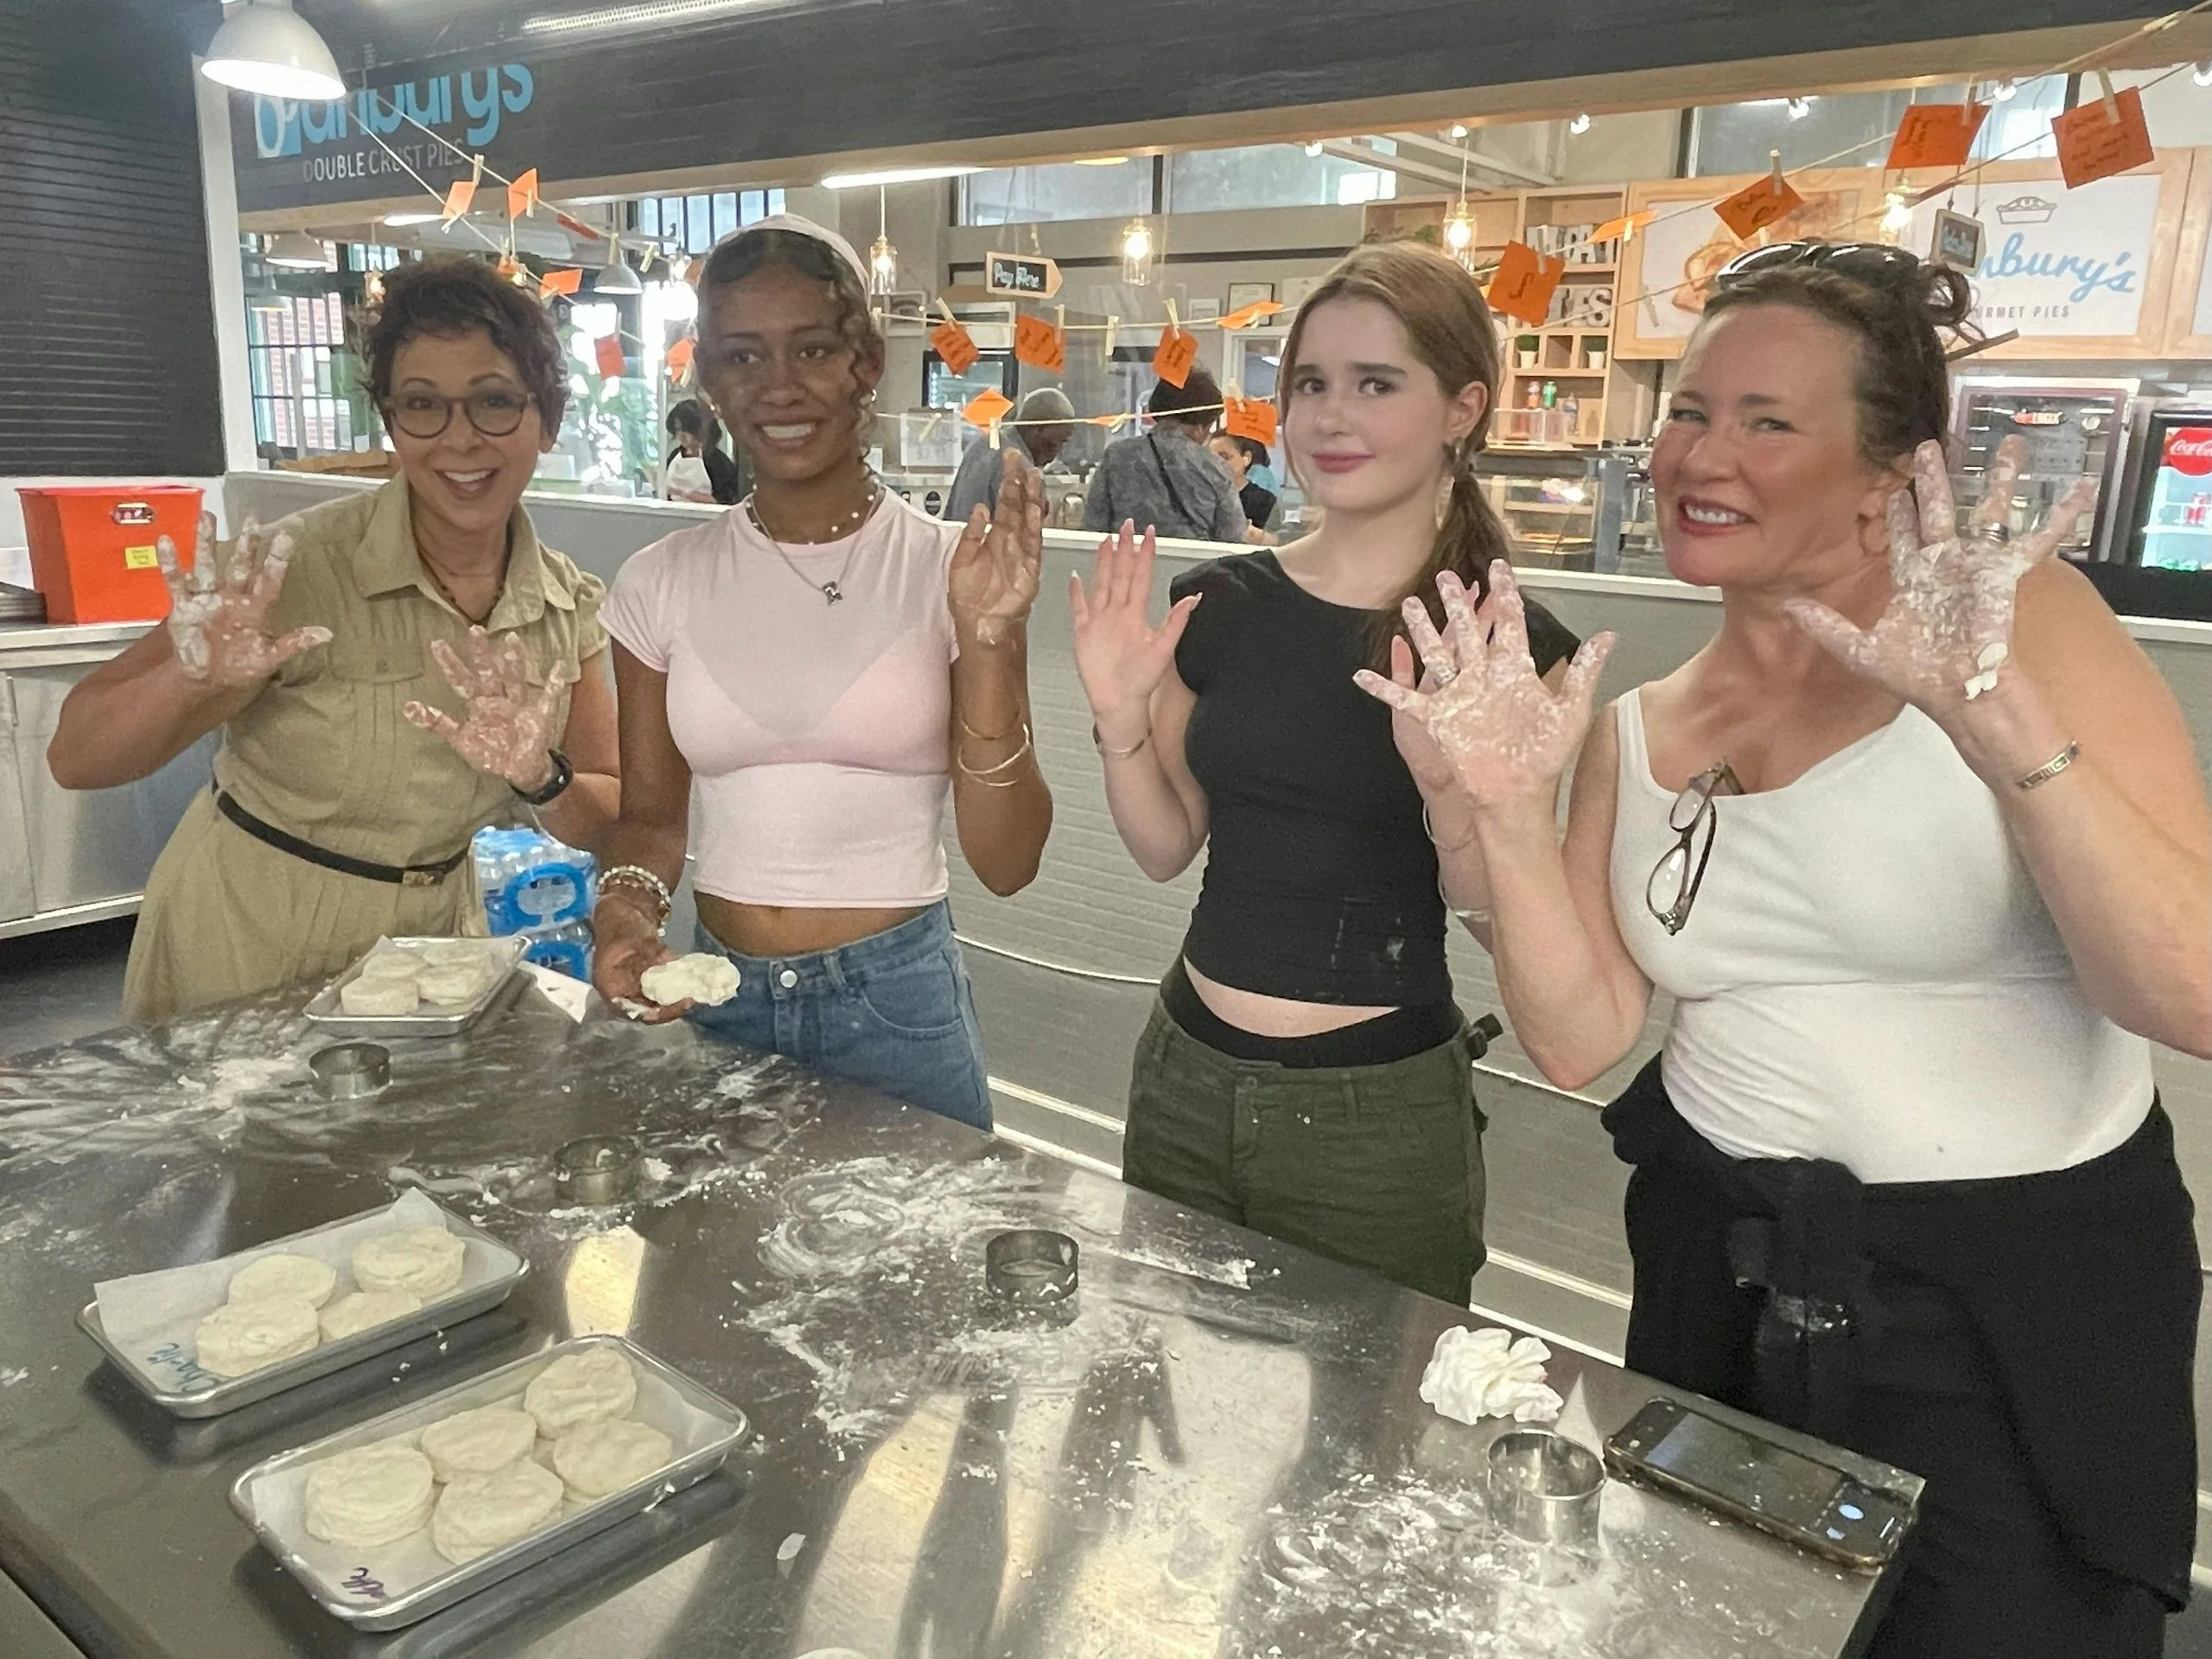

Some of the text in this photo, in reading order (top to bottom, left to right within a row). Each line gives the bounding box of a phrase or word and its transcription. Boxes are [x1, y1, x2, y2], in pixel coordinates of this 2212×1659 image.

[303, 138, 464, 183] DOUBLE CRUST PIES
[2033, 305, 2069, 318] PIES
